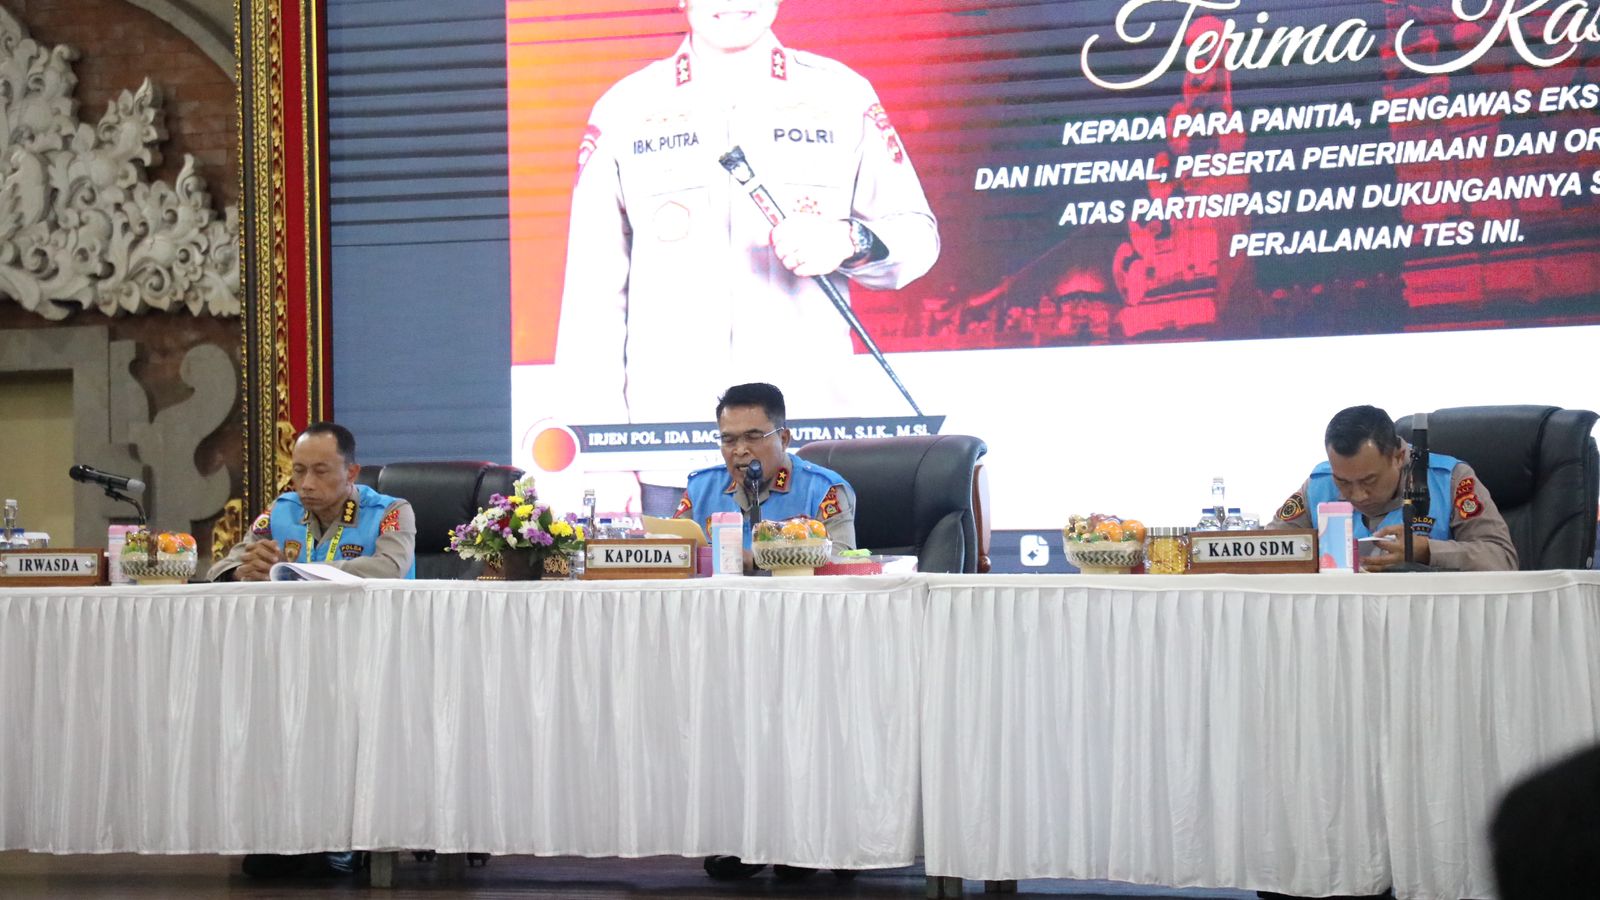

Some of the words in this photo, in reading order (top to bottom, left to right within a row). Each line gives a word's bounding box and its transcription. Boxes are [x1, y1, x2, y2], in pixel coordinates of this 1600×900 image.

[1081, 0, 1376, 90] Terima
[1063, 116, 1167, 146] KEPADA
[1172, 110, 1244, 138] PARA
[1250, 103, 1362, 133] PANITIA,
[1369, 90, 1532, 124] PENGAWAS
[1538, 83, 1600, 112] EKS
[659, 132, 699, 151] PUTRA
[774, 127, 834, 144] POLRI
[974, 165, 1030, 190] DAN
[1033, 157, 1168, 187] INTERNAL,
[1174, 149, 1296, 178] PESERTA
[1301, 135, 1488, 170] PENERIMAAN
[1493, 131, 1557, 157] DAN
[1564, 127, 1600, 153] OR
[1058, 199, 1126, 226] ATAS
[1130, 190, 1292, 222] PARTISIPASI
[1296, 185, 1356, 213] DAN
[1362, 172, 1568, 209] DUKUNGANNYA
[1229, 224, 1414, 258] PERJALANAN
[1421, 221, 1475, 247] TES
[1481, 218, 1524, 244] INI.
[664, 430, 690, 444] IDA
[605, 549, 672, 563] KAPOLDA
[1208, 541, 1255, 557] KARO
[1259, 540, 1295, 556] SDM
[18, 558, 79, 572] IRWASDA
